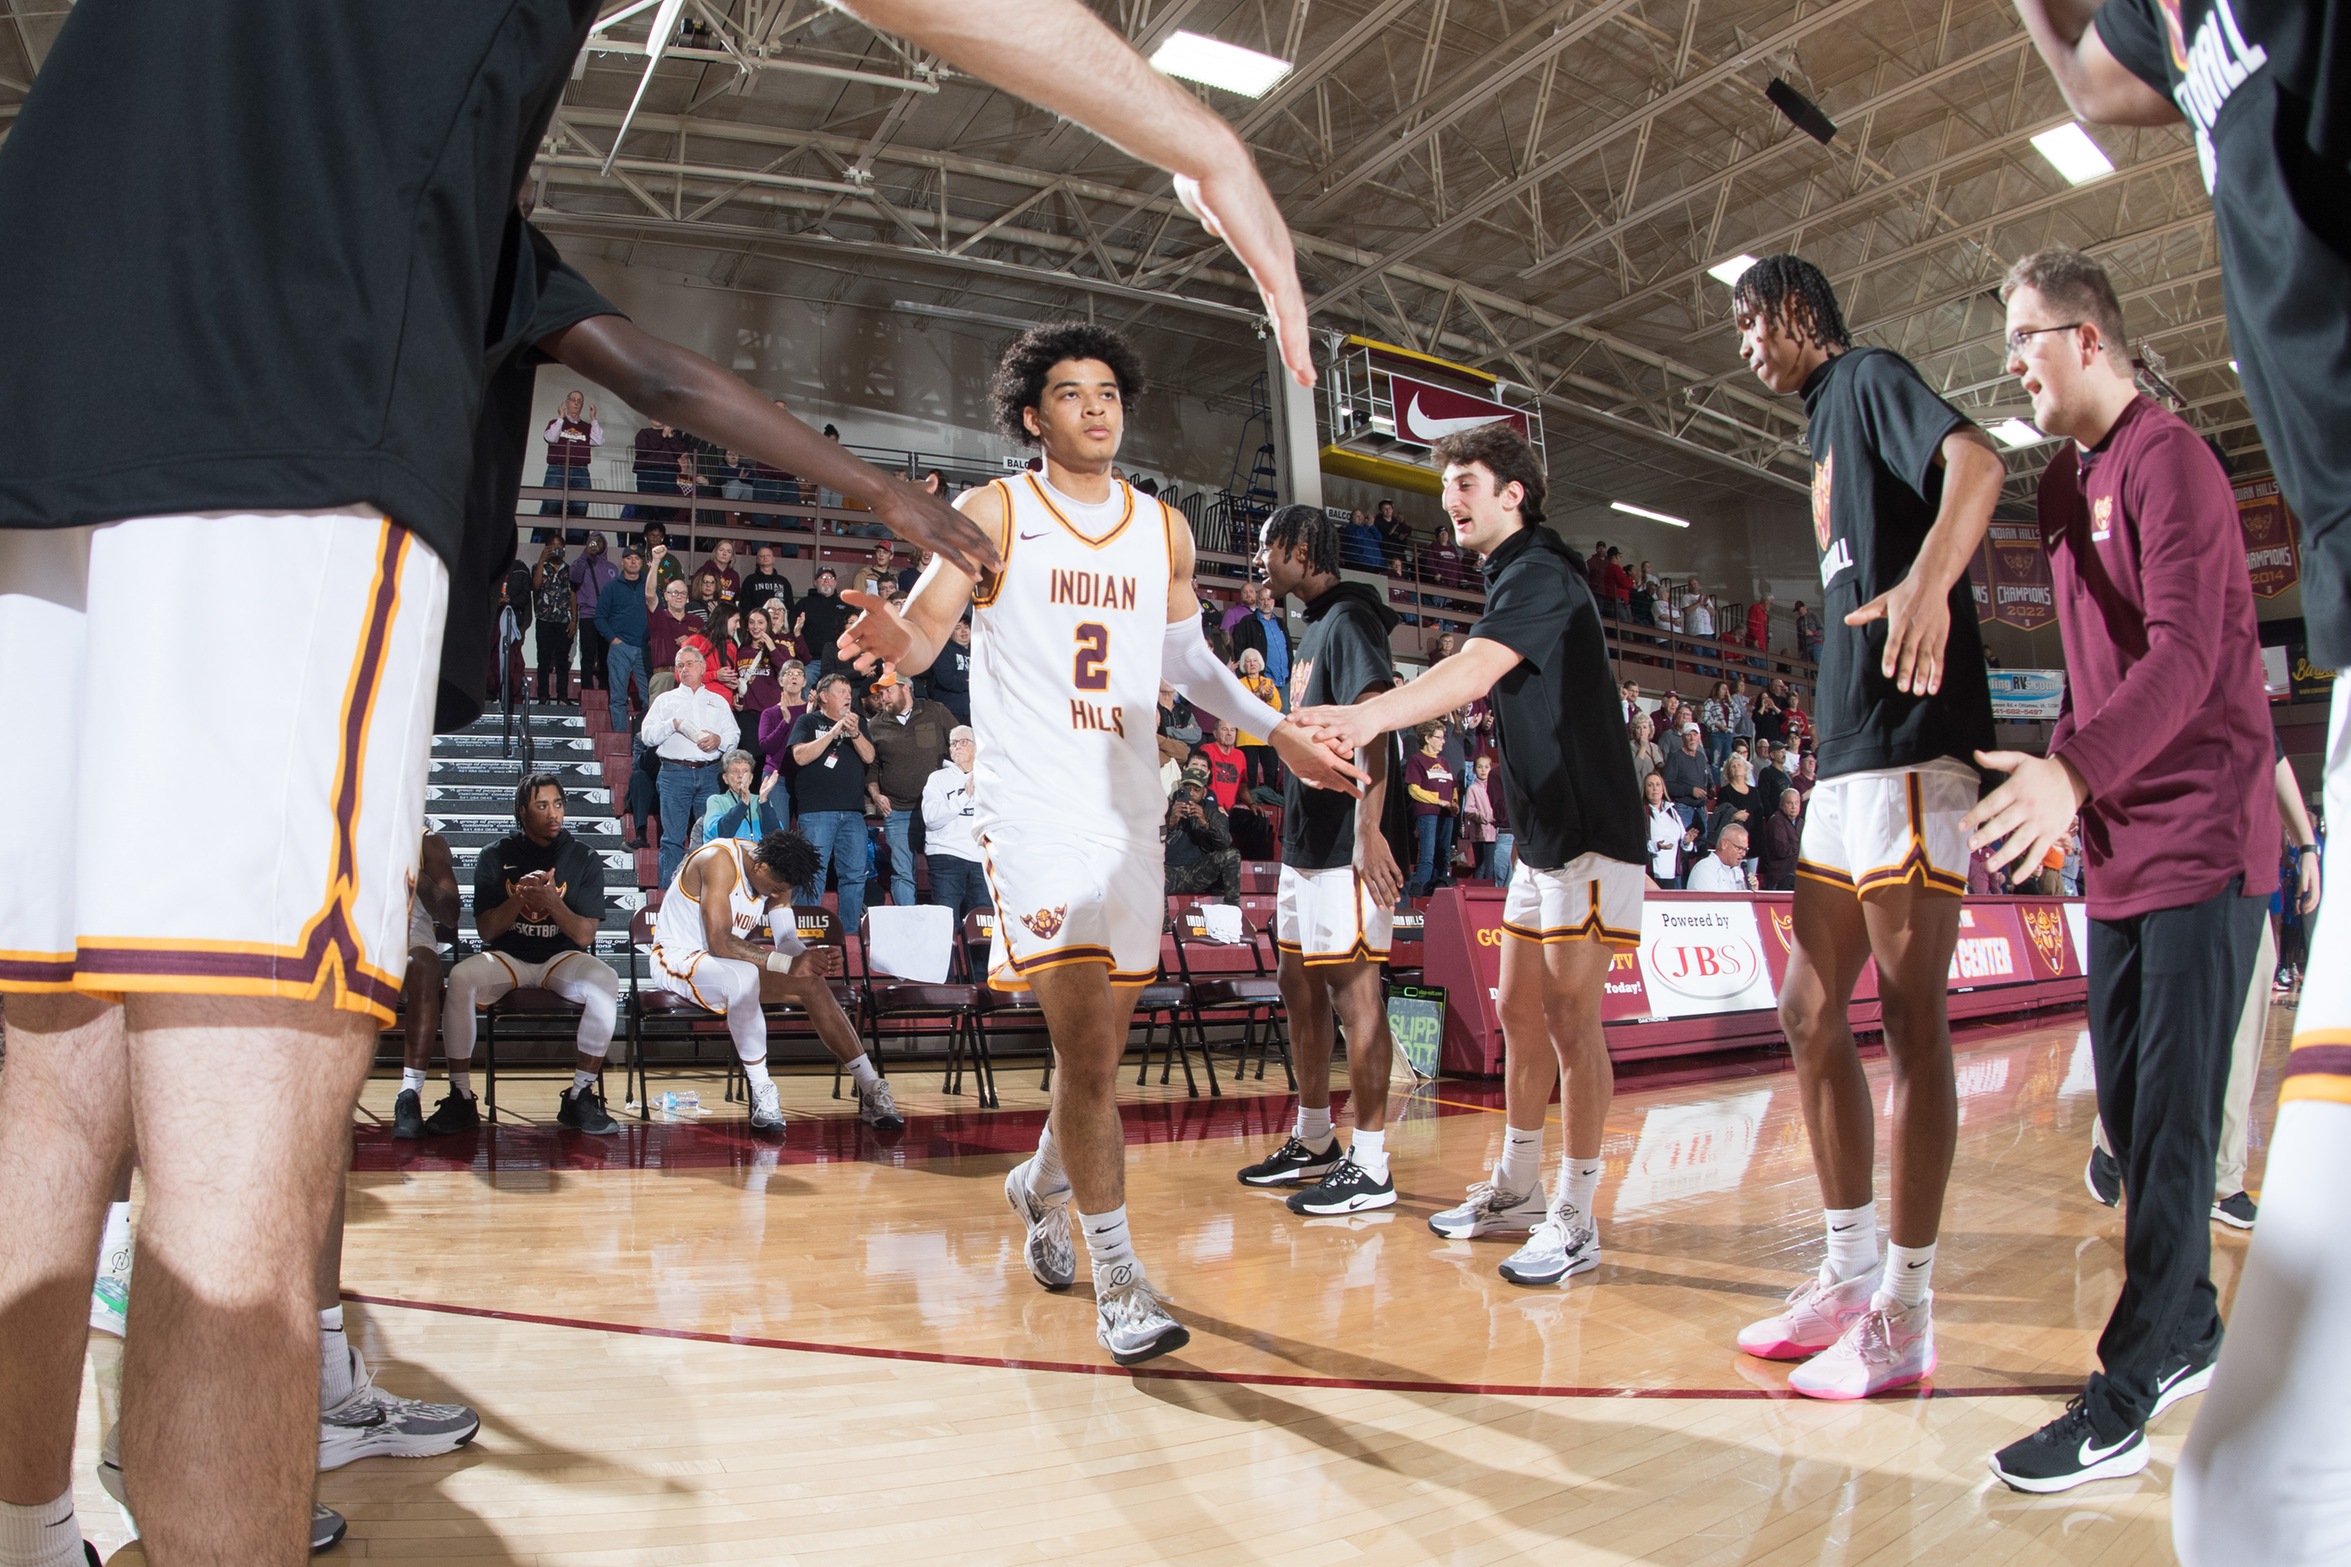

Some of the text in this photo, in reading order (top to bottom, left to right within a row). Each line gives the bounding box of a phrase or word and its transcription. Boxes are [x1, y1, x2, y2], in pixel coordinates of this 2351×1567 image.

[1328, 509, 1351, 520] BALCO
[1050, 568, 1137, 611] INDIAN
[1997, 585, 2052, 606] CHAMPIONS
[2007, 605, 2046, 617] 2022
[1072, 620, 1111, 692] 2
[798, 915, 829, 928] HILLS
[1186, 914, 1205, 927] INDI
[1662, 913, 1729, 930] Powered by
[1671, 944, 1741, 978] JBS
[1957, 937, 2014, 979] CENTER
[1604, 981, 1643, 995] Today!
[1388, 1014, 1439, 1043] SLIPP
